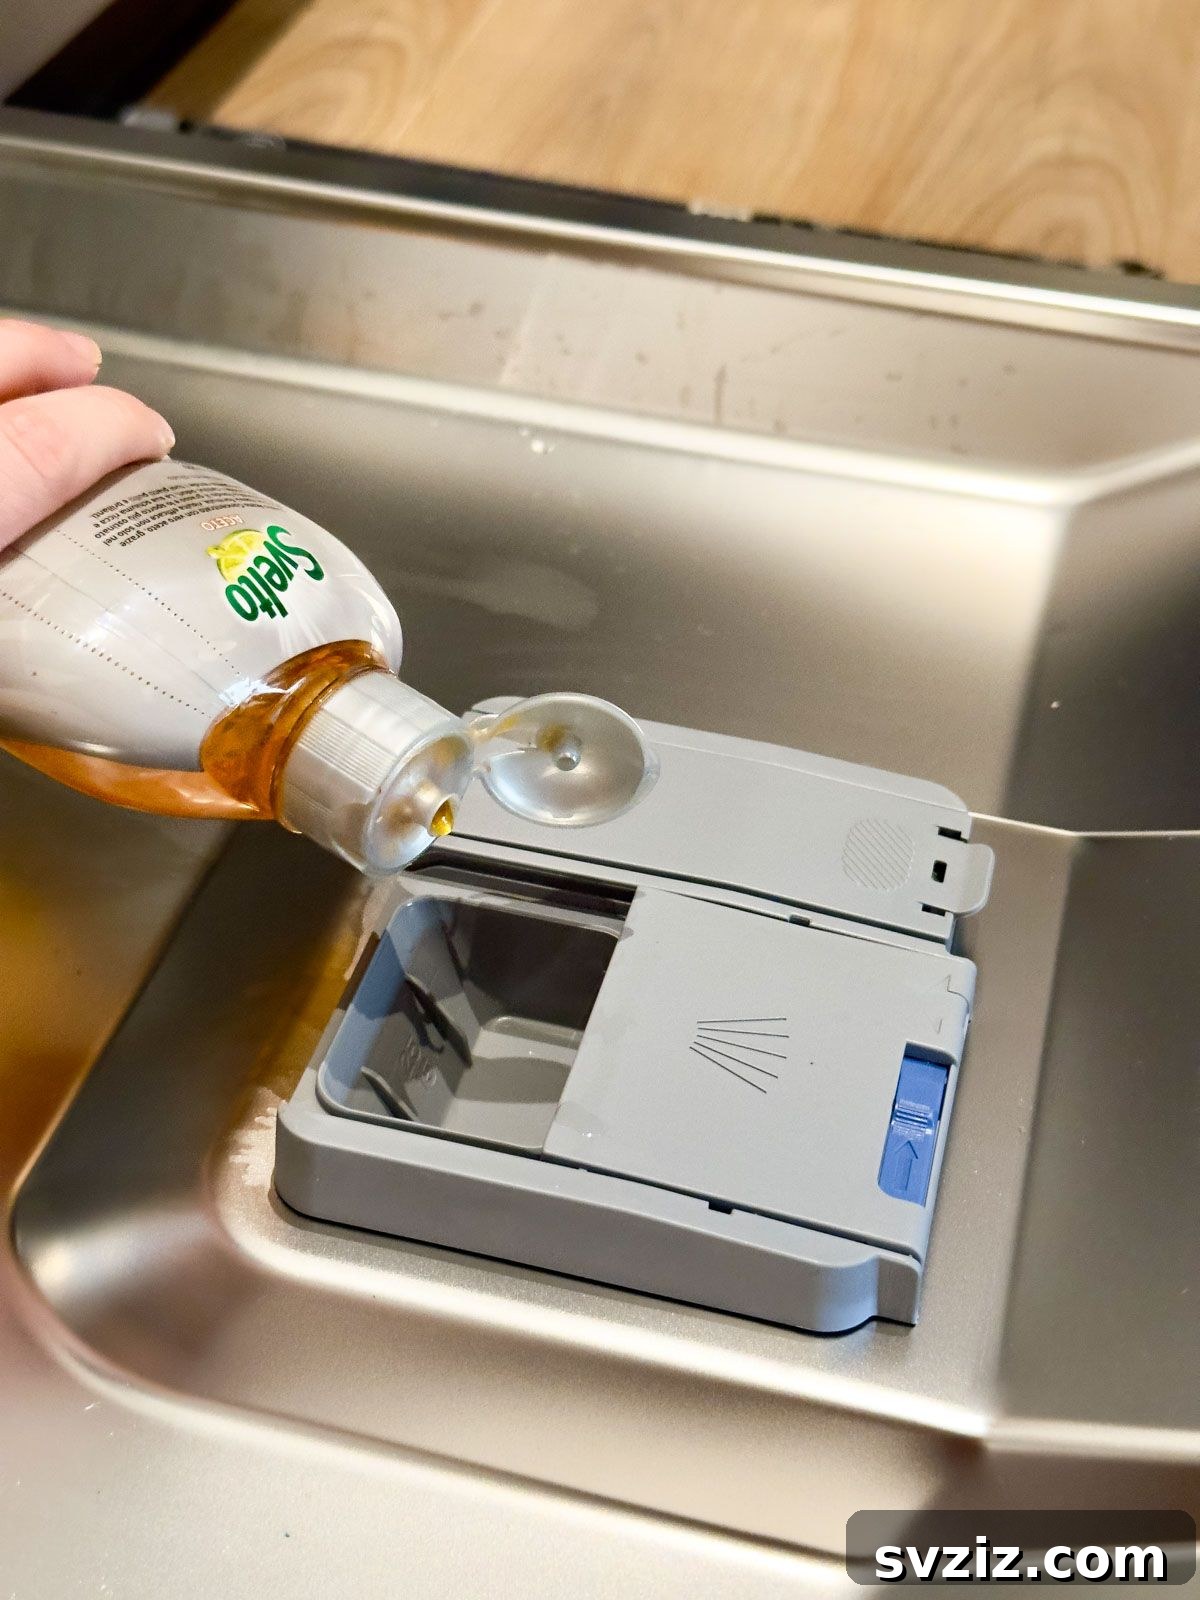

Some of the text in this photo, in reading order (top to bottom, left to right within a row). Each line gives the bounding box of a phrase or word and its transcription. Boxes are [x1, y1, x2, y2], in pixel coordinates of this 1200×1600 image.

[100, 512, 120, 525] ricca
[134, 518, 151, 528] non
[201, 515, 243, 531] ACETO
[94, 518, 128, 539] ostinato
[117, 525, 135, 537] solo
[103, 535, 118, 546] nel
[120, 530, 146, 547] grazie
[225, 525, 325, 621] Svelto
